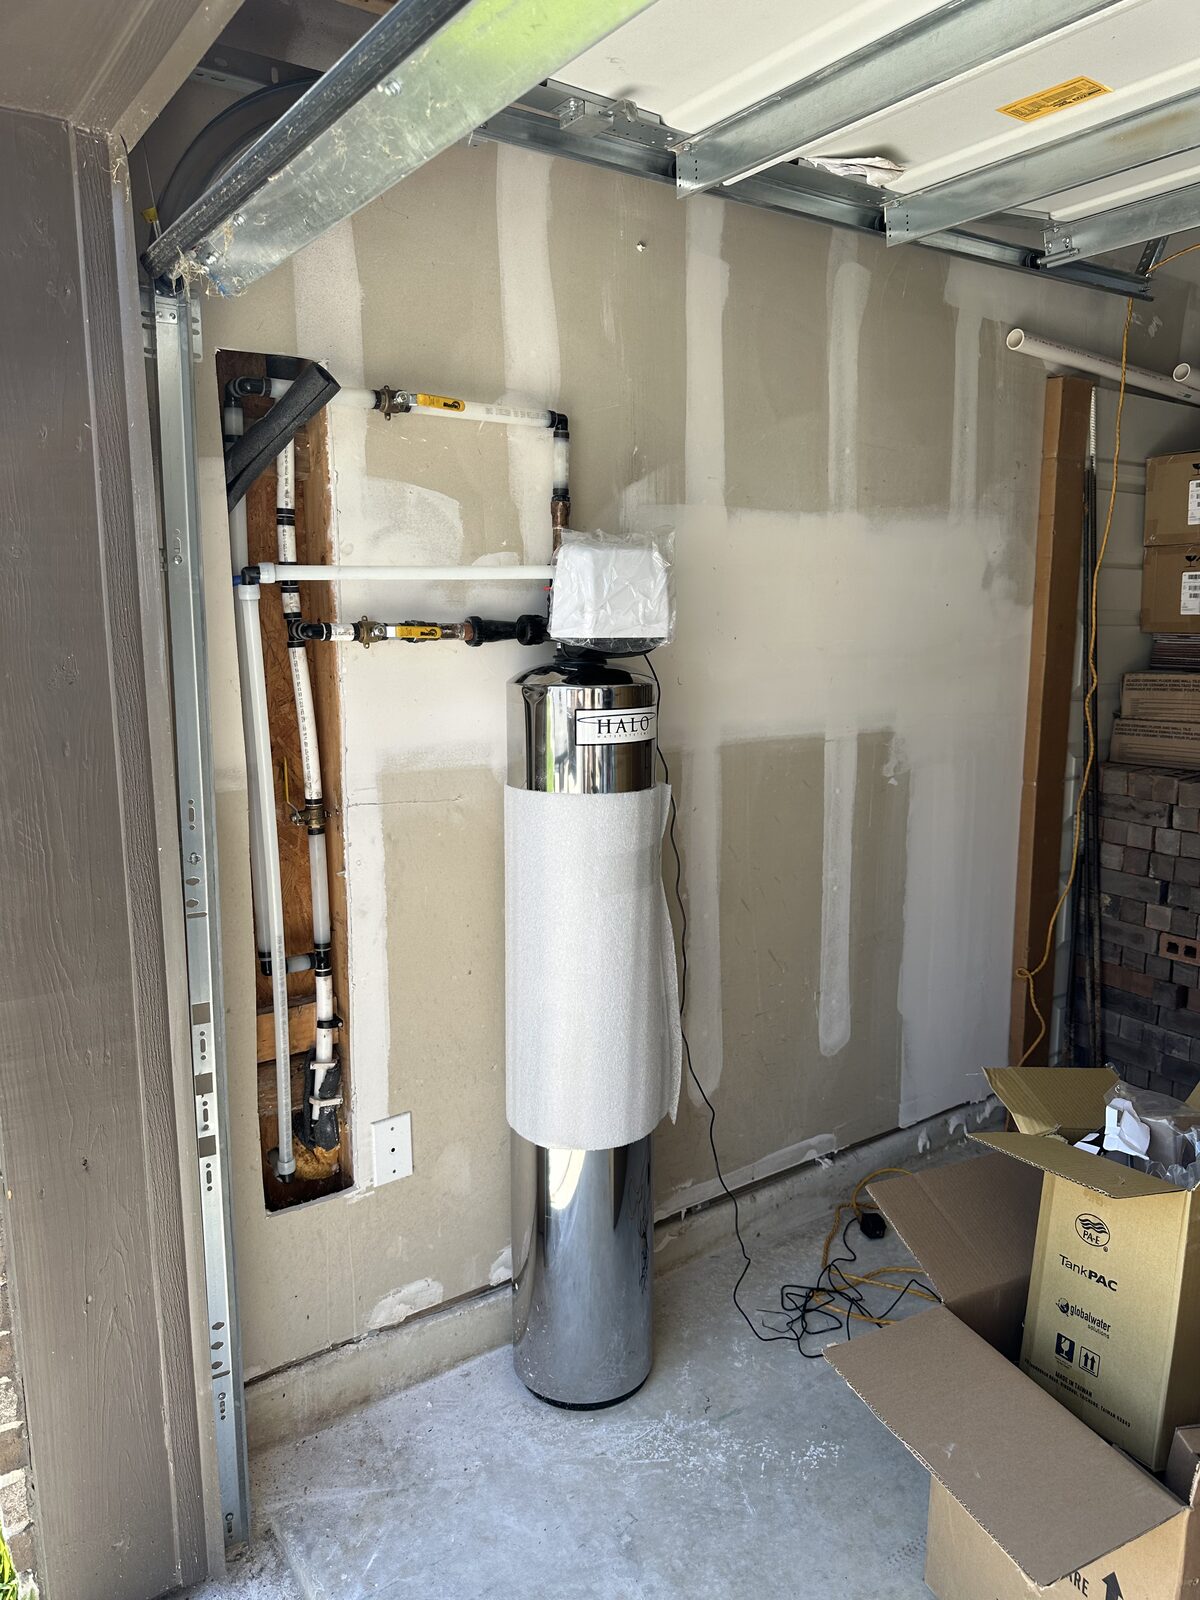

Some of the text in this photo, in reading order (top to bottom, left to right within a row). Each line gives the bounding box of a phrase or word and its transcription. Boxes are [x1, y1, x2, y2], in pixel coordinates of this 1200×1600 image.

[597, 716, 649, 734] HALO
[1083, 1230, 1100, 1245] PA-E
[1059, 1254, 1118, 1292] TankPAC
[1070, 1305, 1111, 1332] globalwater
[1088, 1324, 1110, 1339] solutions
[1055, 1371, 1069, 1384] MADE
[1075, 1382, 1093, 1398] TAIWAN
